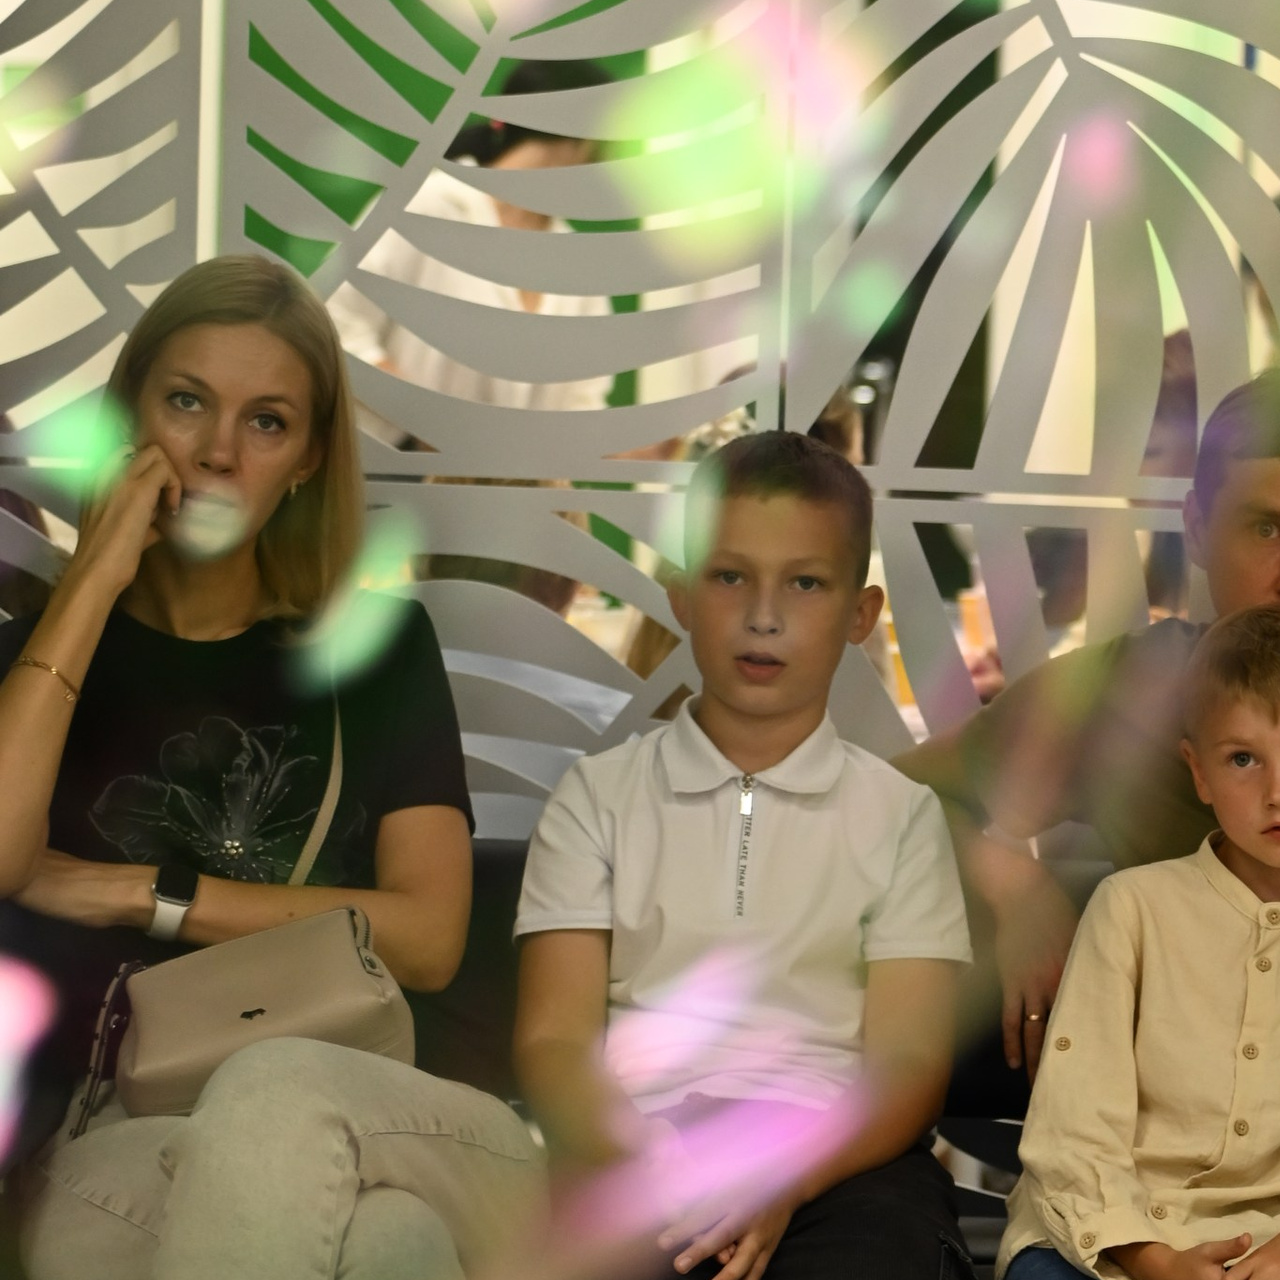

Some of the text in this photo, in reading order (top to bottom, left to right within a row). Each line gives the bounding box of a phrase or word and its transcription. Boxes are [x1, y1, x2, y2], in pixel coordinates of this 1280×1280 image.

[736, 814, 752, 917] TTER LATE THAN NEVER
